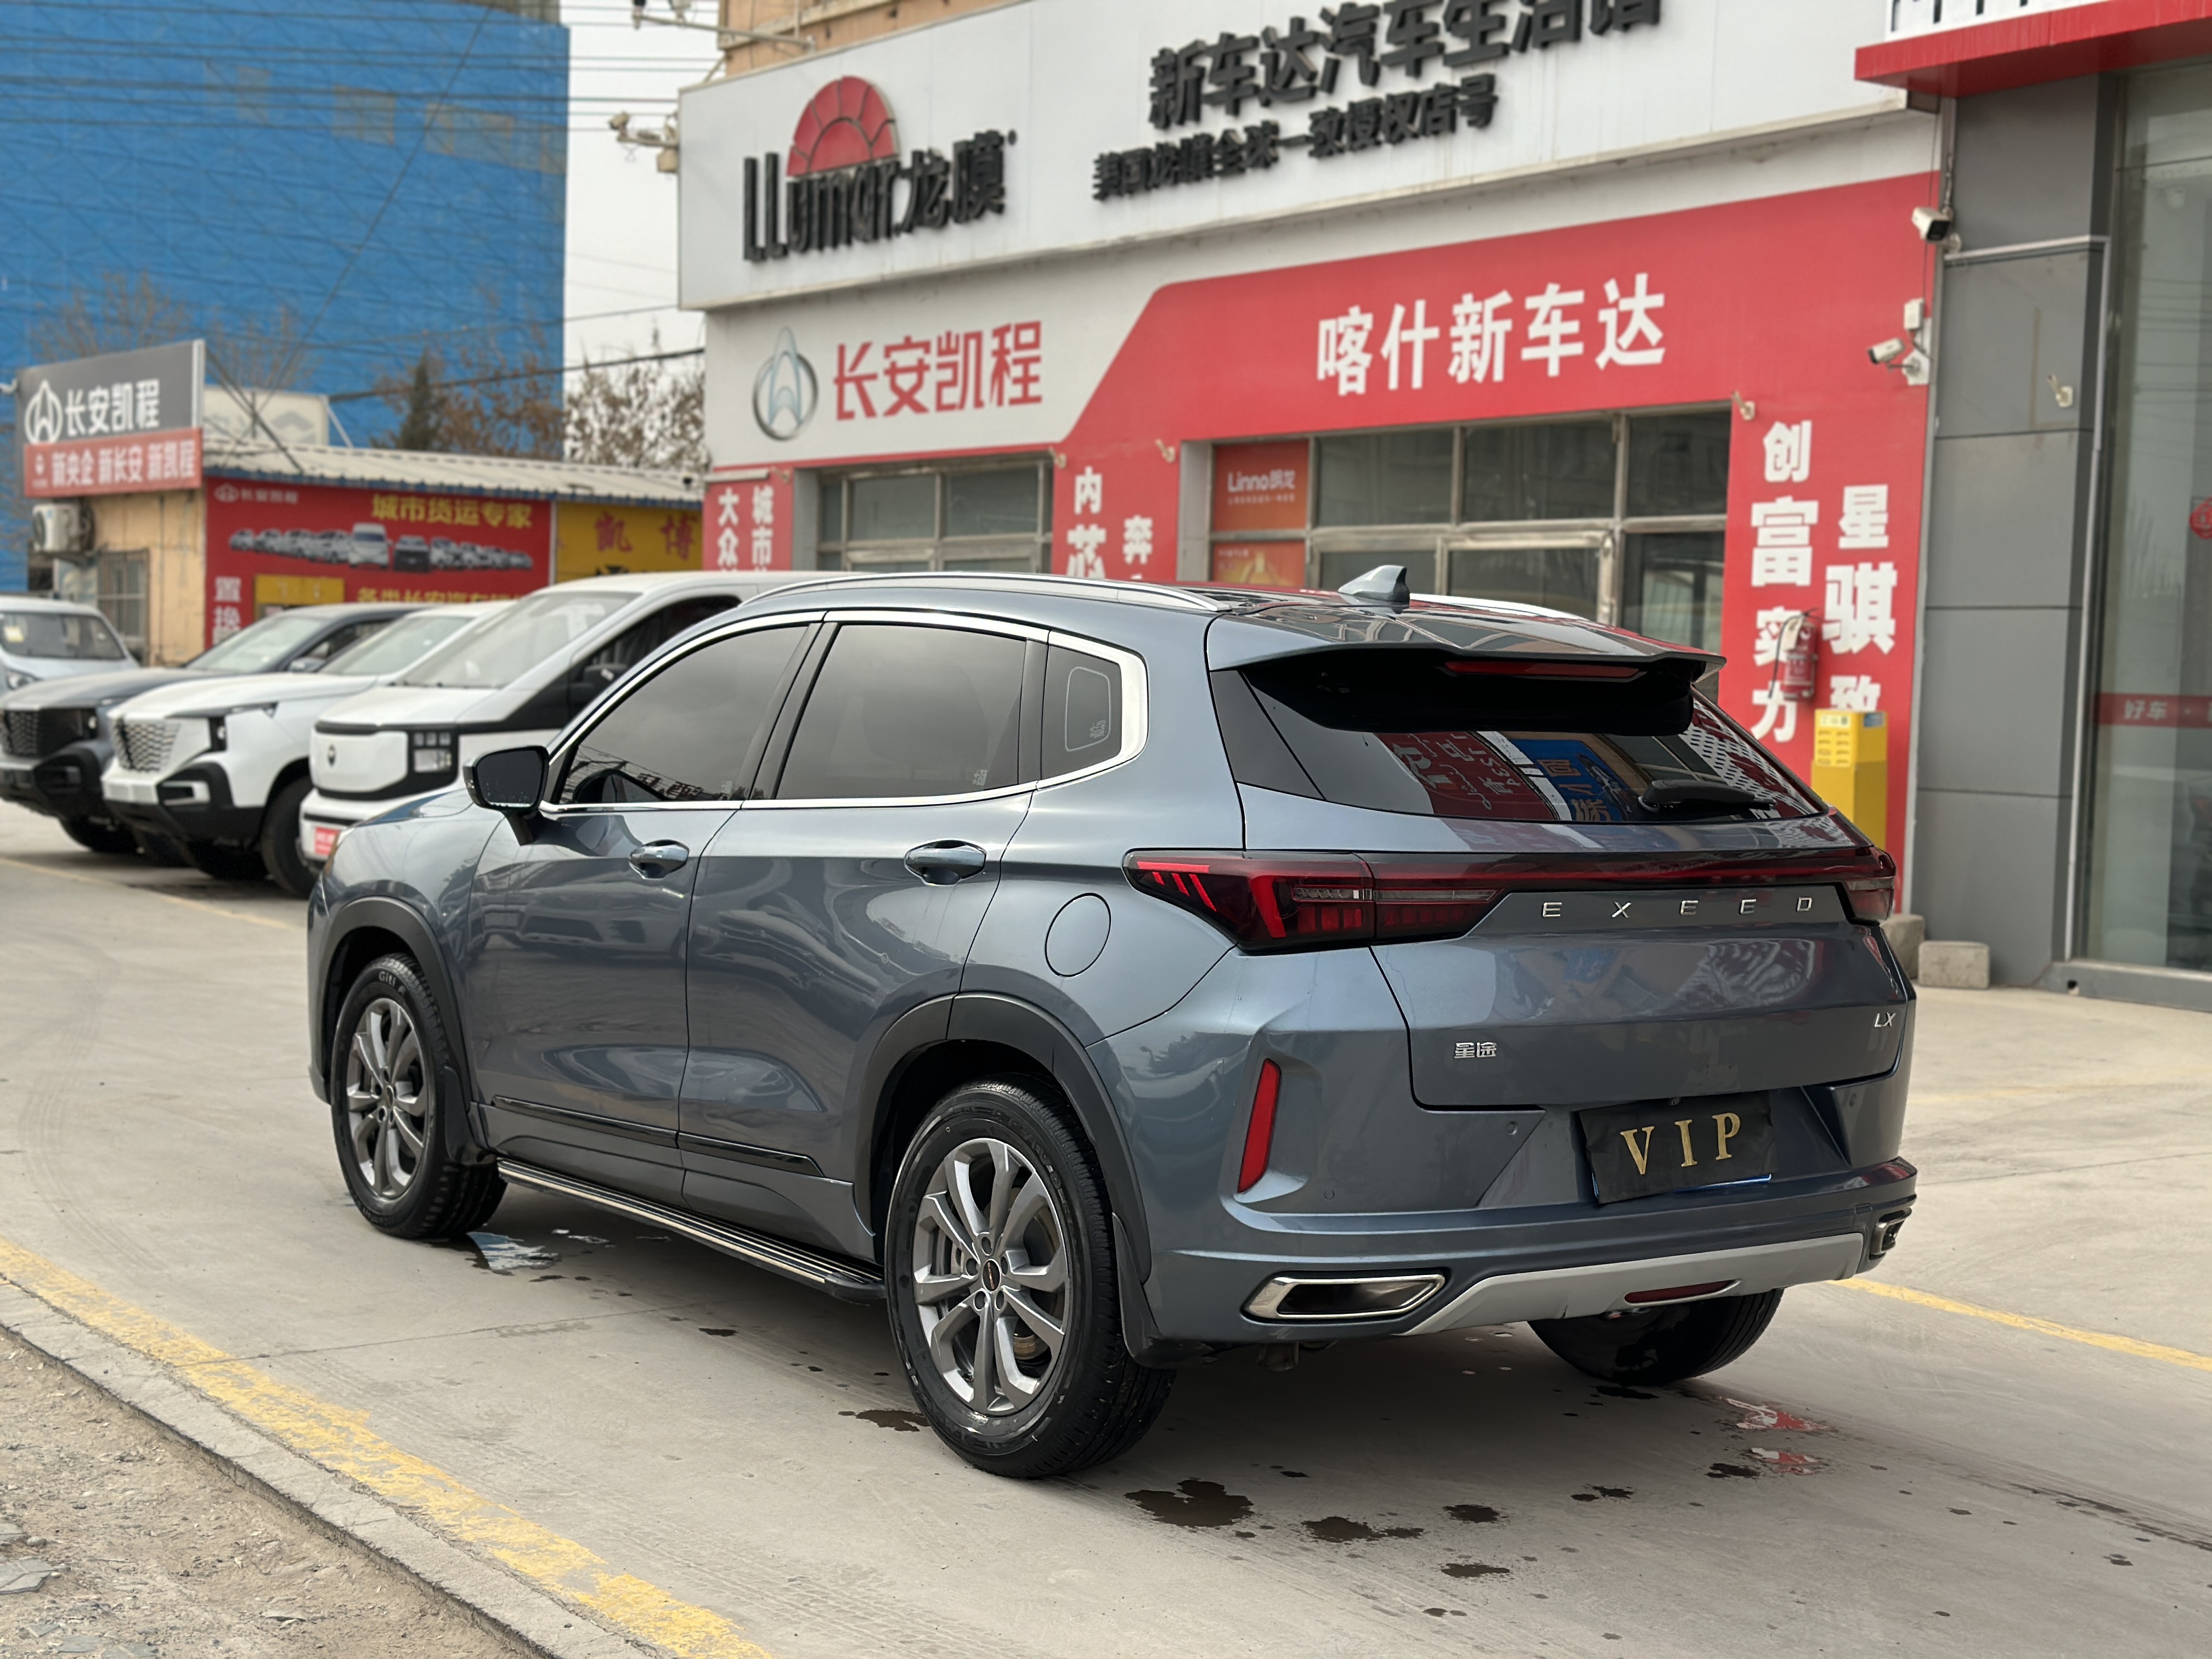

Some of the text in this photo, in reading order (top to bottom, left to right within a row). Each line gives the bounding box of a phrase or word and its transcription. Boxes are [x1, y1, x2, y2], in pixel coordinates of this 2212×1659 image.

[1317, 273, 1666, 396] 喀什新车达
[833, 320, 1043, 421] 长安凯程
[65, 379, 160, 437] 长安凯程
[98, 444, 143, 485] 新长安
[146, 439, 195, 481] 新凯程
[1227, 470, 1269, 493] Linno
[371, 494, 532, 529] 城市货运专家
[718, 486, 740, 571] 大众
[1751, 420, 1819, 743] 创富实力
[1542, 897, 1813, 918] EXEED
[379, 971, 396, 987] Giti
[1874, 1012, 1897, 1028] LX
[1454, 1041, 1498, 1059] 星途
[1620, 1111, 1741, 1175] VIP
